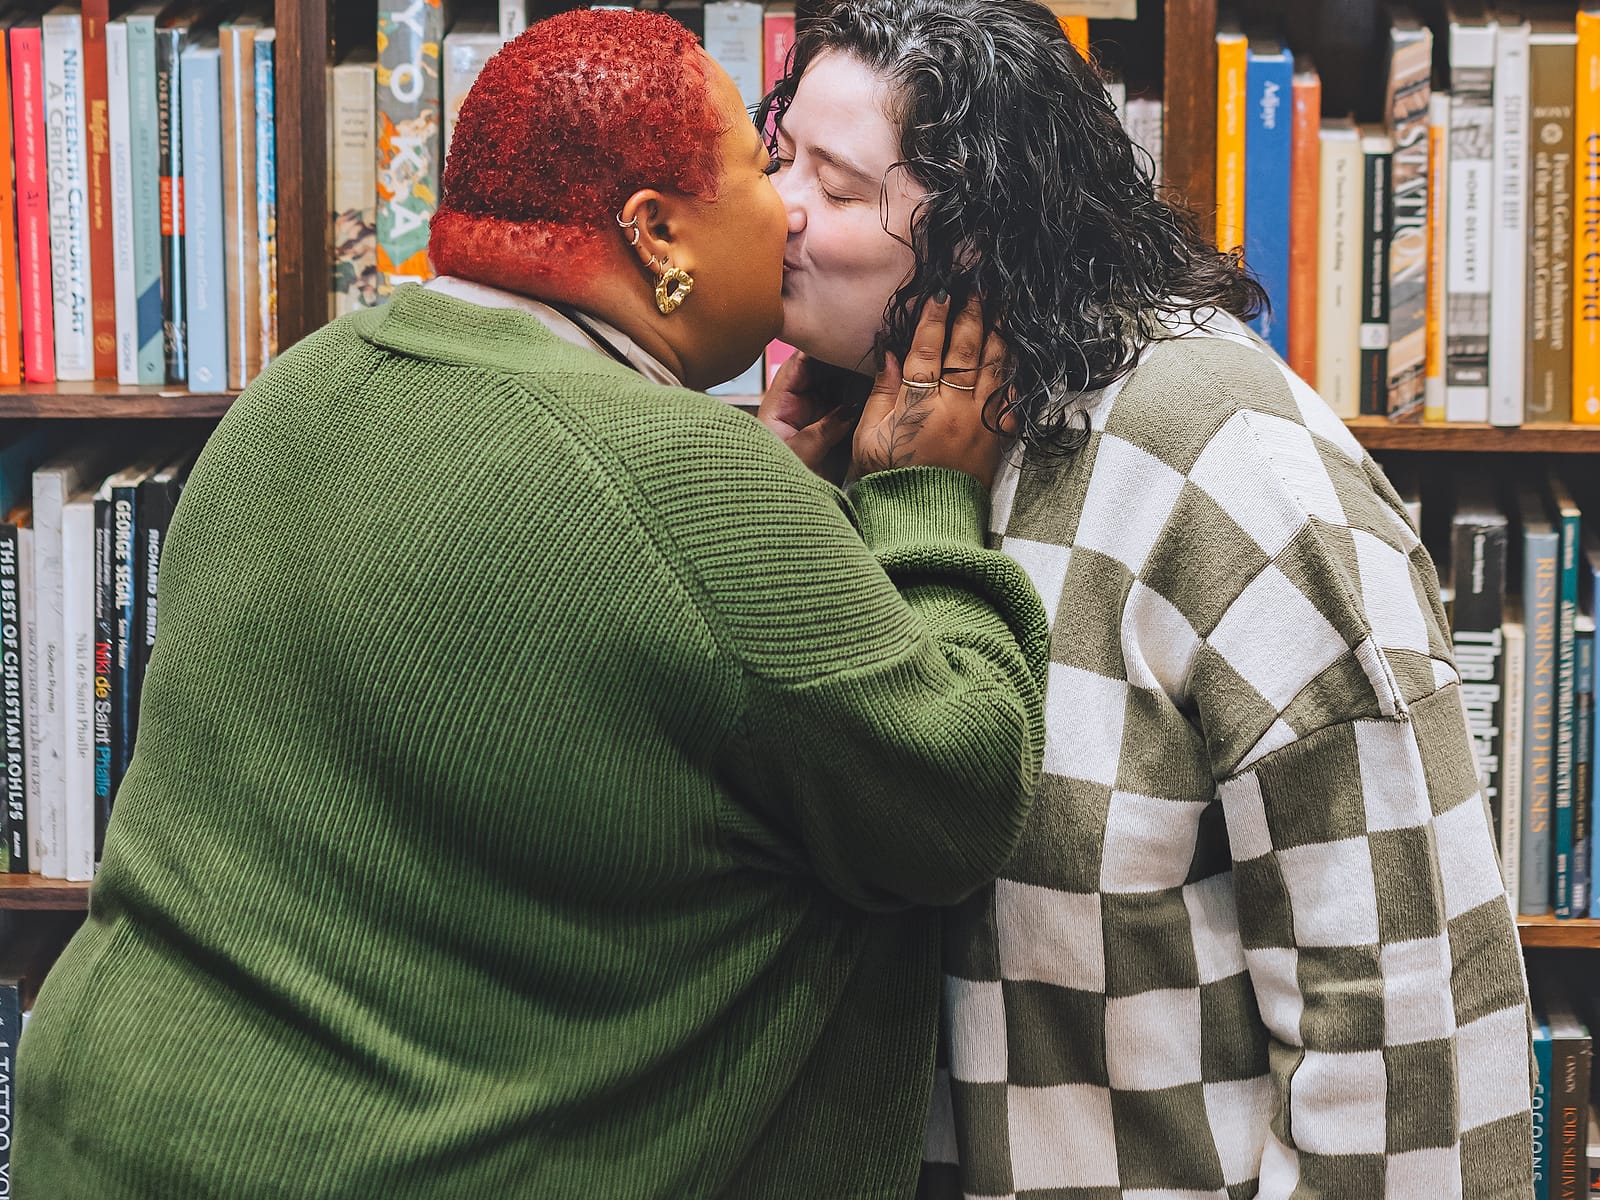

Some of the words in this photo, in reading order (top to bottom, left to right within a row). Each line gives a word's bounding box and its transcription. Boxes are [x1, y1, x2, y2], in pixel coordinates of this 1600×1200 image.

[48, 82, 65, 99] A
[64, 49, 81, 181] NINETEENTH
[1260, 82, 1281, 129] Adjaye
[49, 108, 67, 202] CRITICAL
[1551, 153, 1568, 205] French
[1395, 125, 1427, 287] STATION
[1465, 169, 1476, 211] HOME
[67, 188, 84, 287] CENTURY
[1465, 217, 1477, 283] DELIVERY
[1552, 207, 1567, 256] Gothic
[52, 212, 70, 306] HISTORY
[71, 292, 86, 335] ART
[1550, 260, 1566, 350] Architecture
[115, 501, 131, 560] GEORGE
[1, 539, 14, 575] THE
[146, 530, 159, 593] RICHARD
[2, 579, 15, 620] BEST
[115, 565, 130, 609] SEGAL
[3, 625, 17, 647] OF
[146, 598, 157, 645] SERRA
[1533, 558, 1555, 685] RESTORING
[76, 633, 88, 661] Niki
[77, 664, 87, 678] de
[95, 643, 110, 673] Niki
[1454, 630, 1500, 681] The
[6, 652, 20, 747] CHRISTIAN
[77, 682, 88, 714] Saint
[96, 677, 110, 697] de
[77, 719, 89, 758] Phalle
[96, 701, 111, 743] Saint
[1533, 692, 1552, 741] OLD
[9, 752, 23, 820] ROHLFS
[96, 747, 111, 796] Phalle
[1531, 746, 1550, 832] HOUSES
[1562, 1107, 1577, 1144] LOUIS
[1562, 1148, 1577, 1200] SULLIVA
